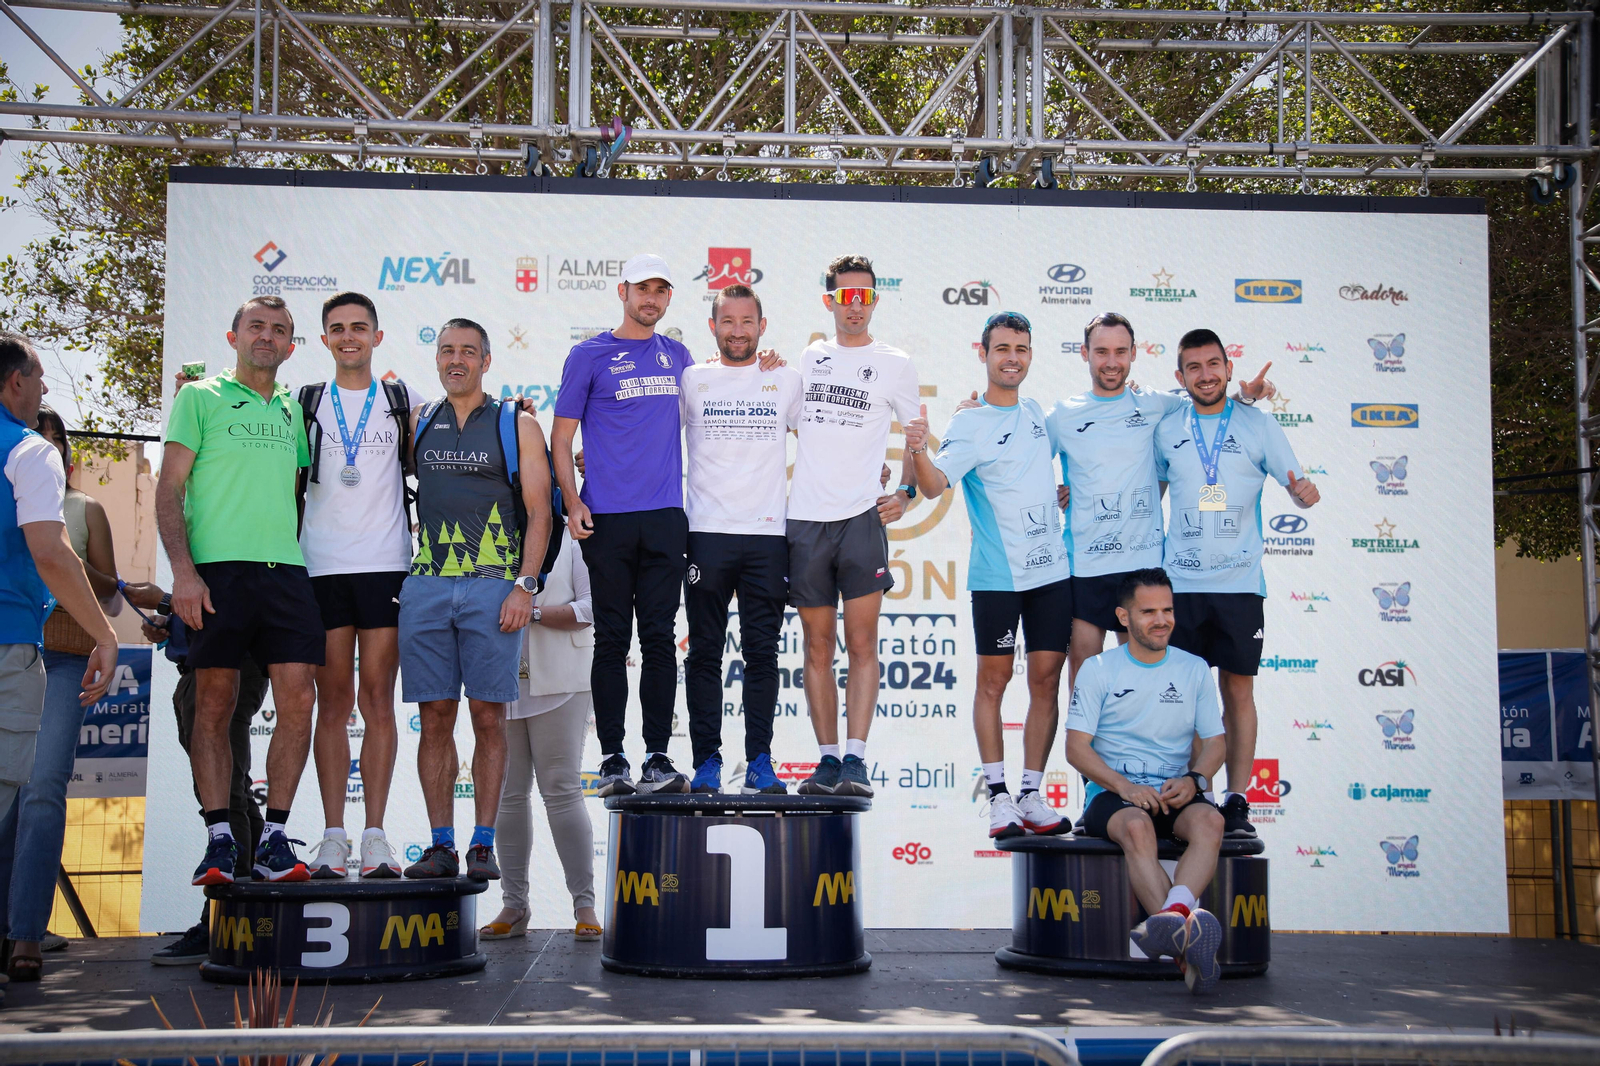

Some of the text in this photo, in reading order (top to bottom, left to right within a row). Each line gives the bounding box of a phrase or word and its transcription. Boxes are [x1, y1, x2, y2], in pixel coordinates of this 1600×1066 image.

[253, 275, 337, 287] COOPERACIÓN
[558, 279, 606, 291] CIUDAD
[252, 285, 281, 295] 2005
[942, 287, 989, 306] CASI
[1038, 286, 1093, 296] HYUNDAI
[1129, 288, 1197, 298] ESTRELLA
[1244, 286, 1294, 297] IKEA
[640, 376, 676, 386] ATLETISMO
[616, 387, 644, 399] PUERTO
[809, 383, 869, 400] CLUB ATLETISMO
[826, 394, 871, 411] TORREVIEJA
[703, 407, 777, 417] Almería 2024
[1360, 410, 1411, 421] IKEA
[242, 441, 275, 449] STONE
[424, 449, 488, 463] CUELLAR
[1199, 483, 1227, 503] 25
[1096, 512, 1120, 521] natural
[1129, 541, 1164, 552] MOBILIAR
[1262, 537, 1315, 546] HYUNDAI
[1352, 538, 1420, 548] ESTRELLA
[1259, 655, 1318, 671] cajamar
[1358, 668, 1405, 687] CASI
[877, 701, 956, 718] NDÚJAR
[898, 761, 955, 788] abril
[1371, 784, 1431, 801] cajamar
[892, 842, 931, 865] ego
[661, 873, 679, 888] 25
[705, 824, 788, 961] 1
[1082, 890, 1100, 903] 25
[256, 917, 274, 932] 25
[300, 902, 351, 968] 3
